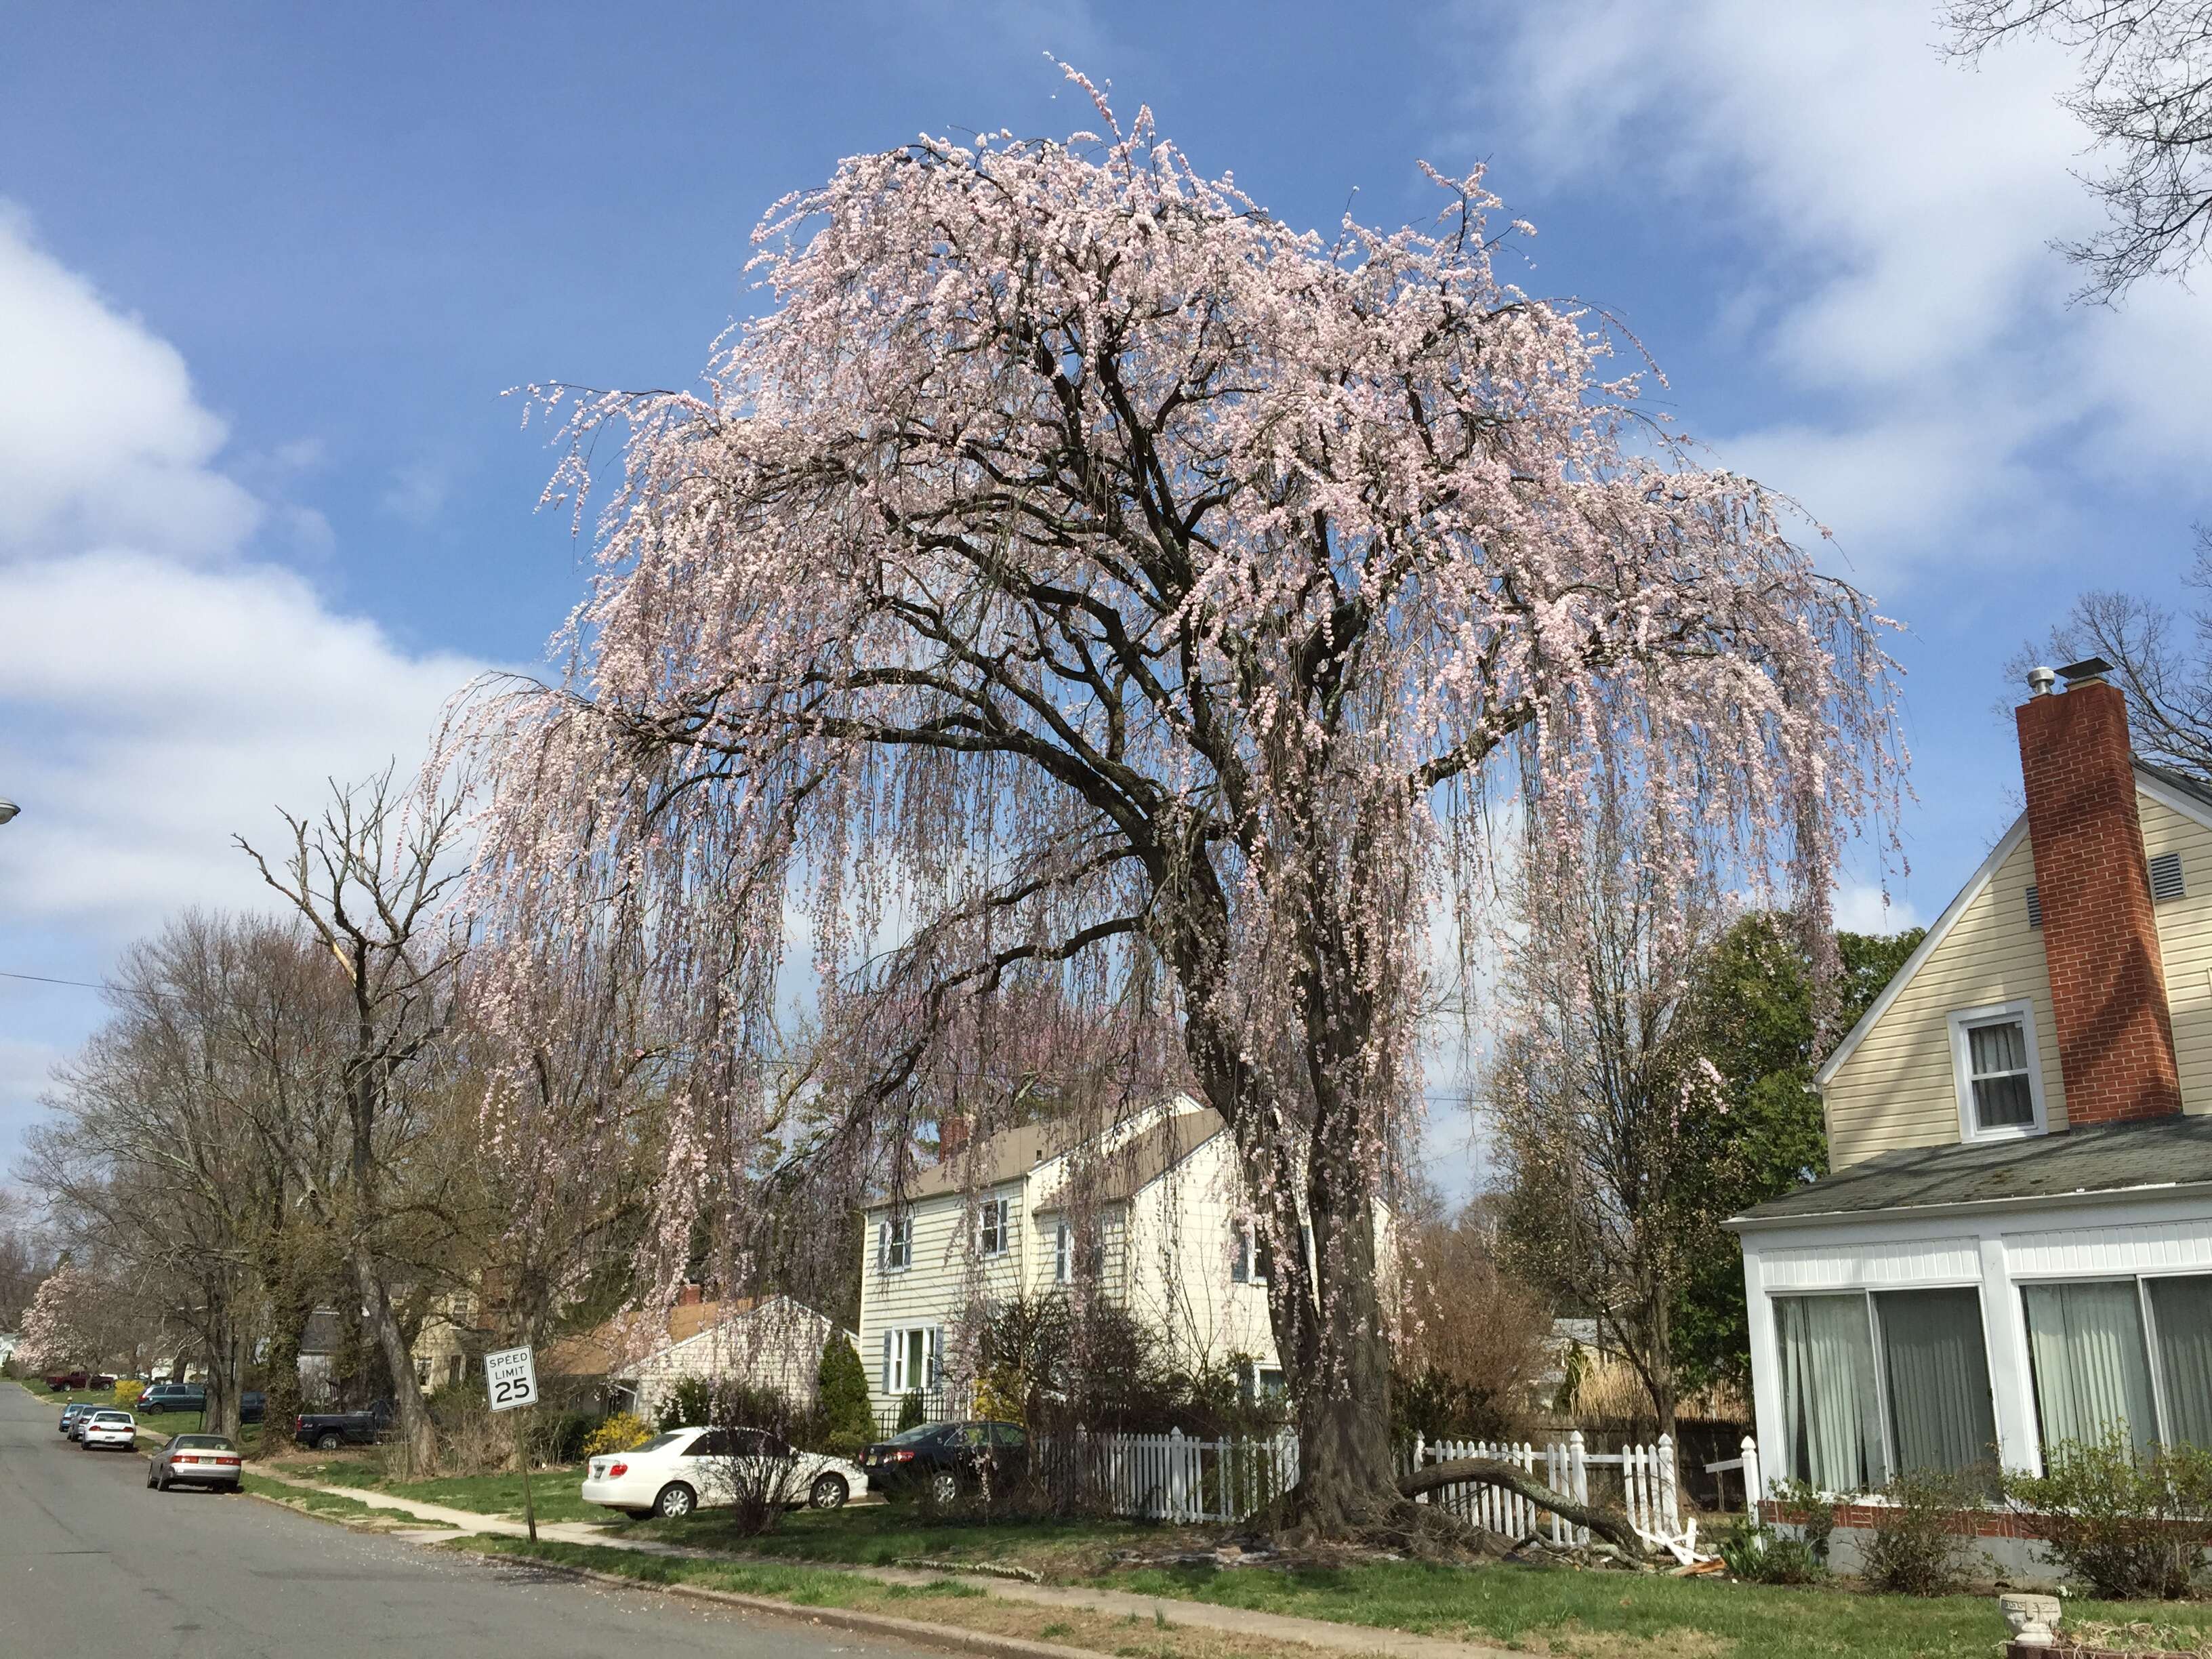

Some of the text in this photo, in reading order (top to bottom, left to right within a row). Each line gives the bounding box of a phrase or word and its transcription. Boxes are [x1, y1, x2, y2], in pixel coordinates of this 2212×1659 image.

[489, 1353, 527, 1368] SPEED
[495, 1366, 524, 1380] LIMIT
[495, 1377, 529, 1403] 25
